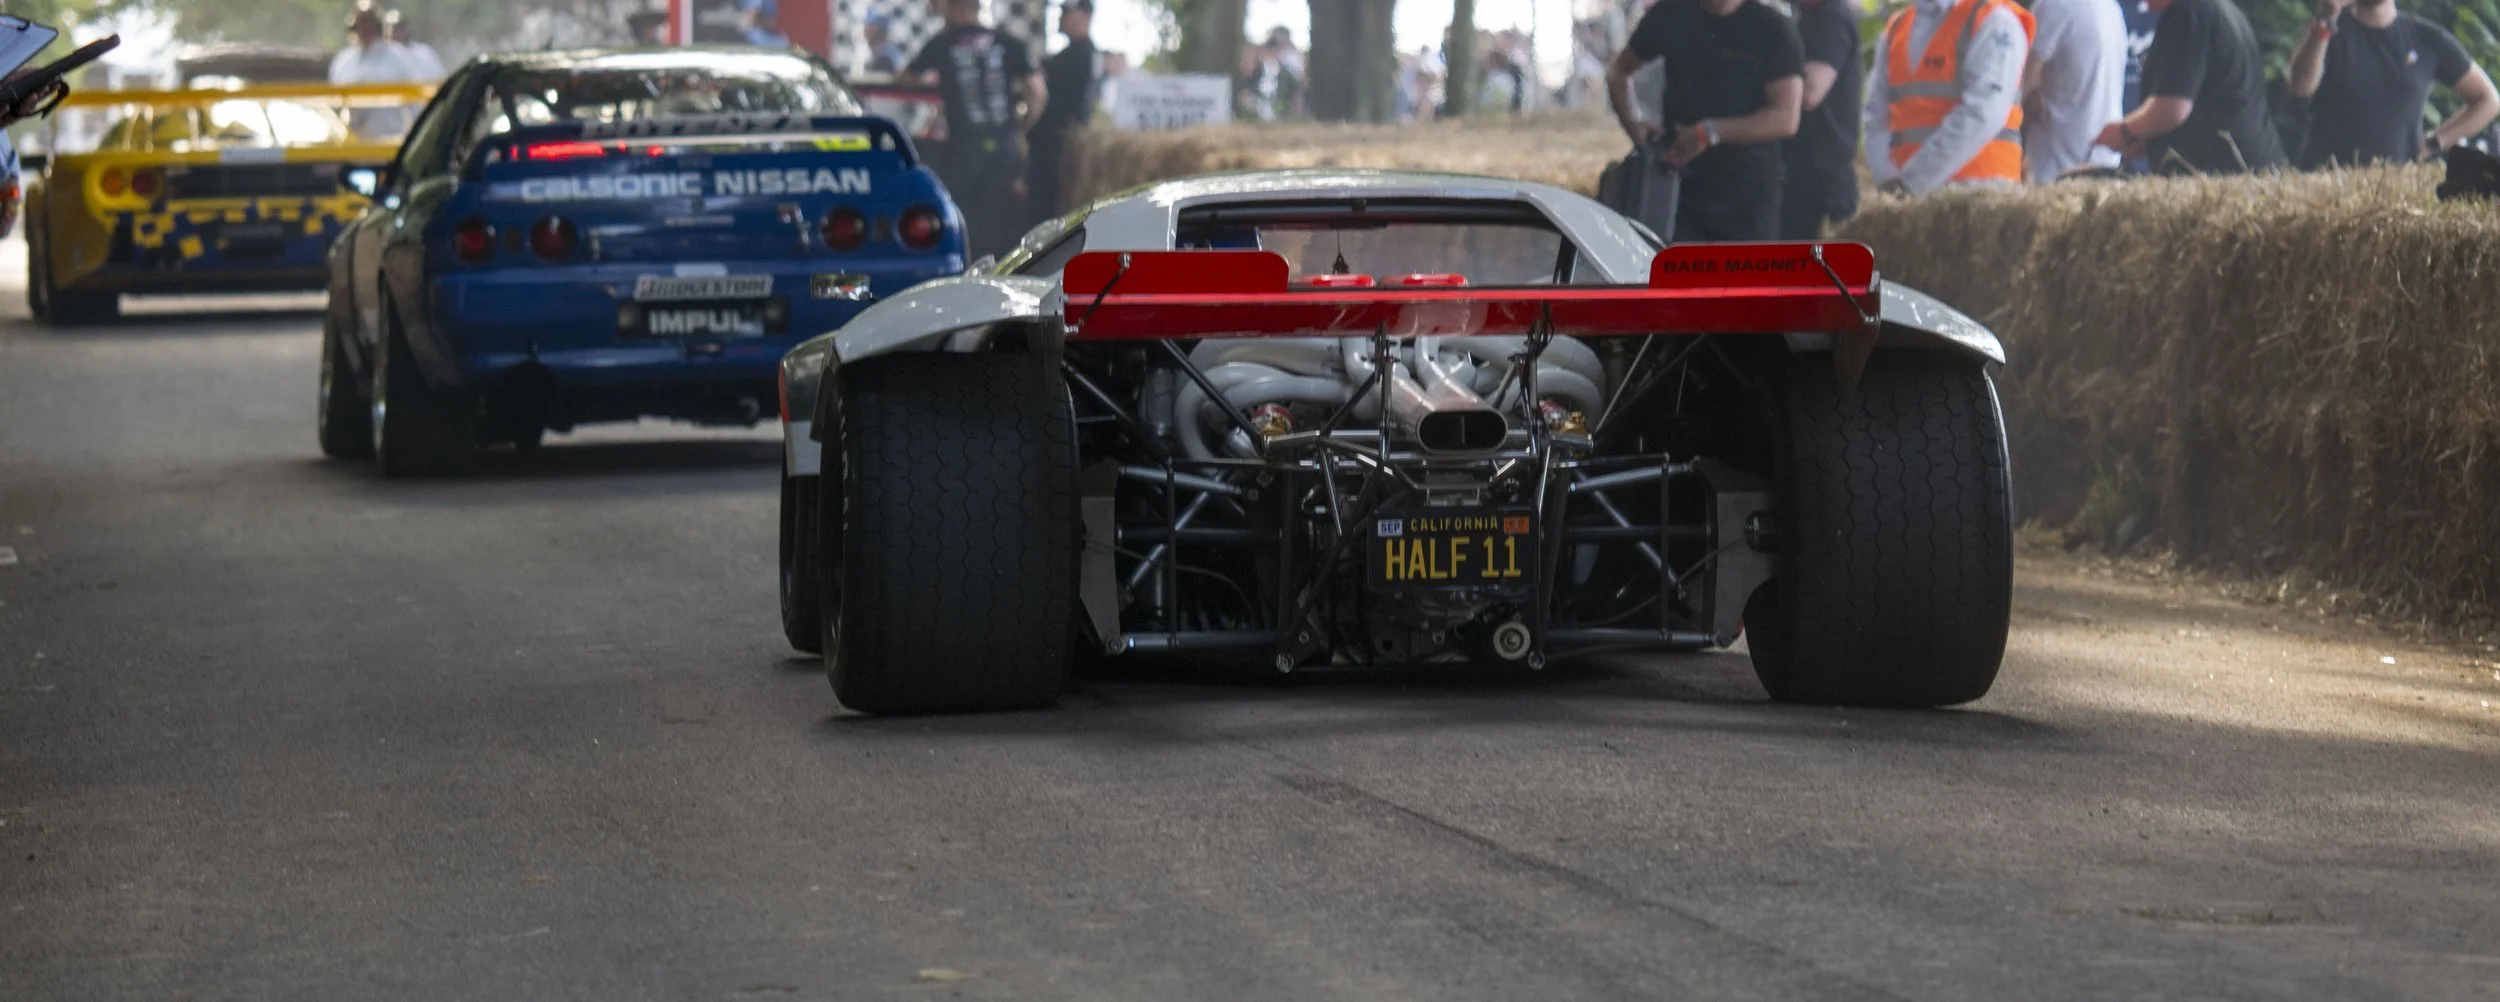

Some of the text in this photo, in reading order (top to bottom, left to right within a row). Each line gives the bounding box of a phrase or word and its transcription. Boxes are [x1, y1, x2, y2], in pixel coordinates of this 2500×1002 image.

[714, 168, 871, 194] NISSAN
[1663, 258, 1808, 273] BABE MAGNET
[651, 309, 757, 334] IMPUL
[1410, 516, 1498, 532] CALIFORNIA
[1385, 535, 1521, 580] HALF 11
